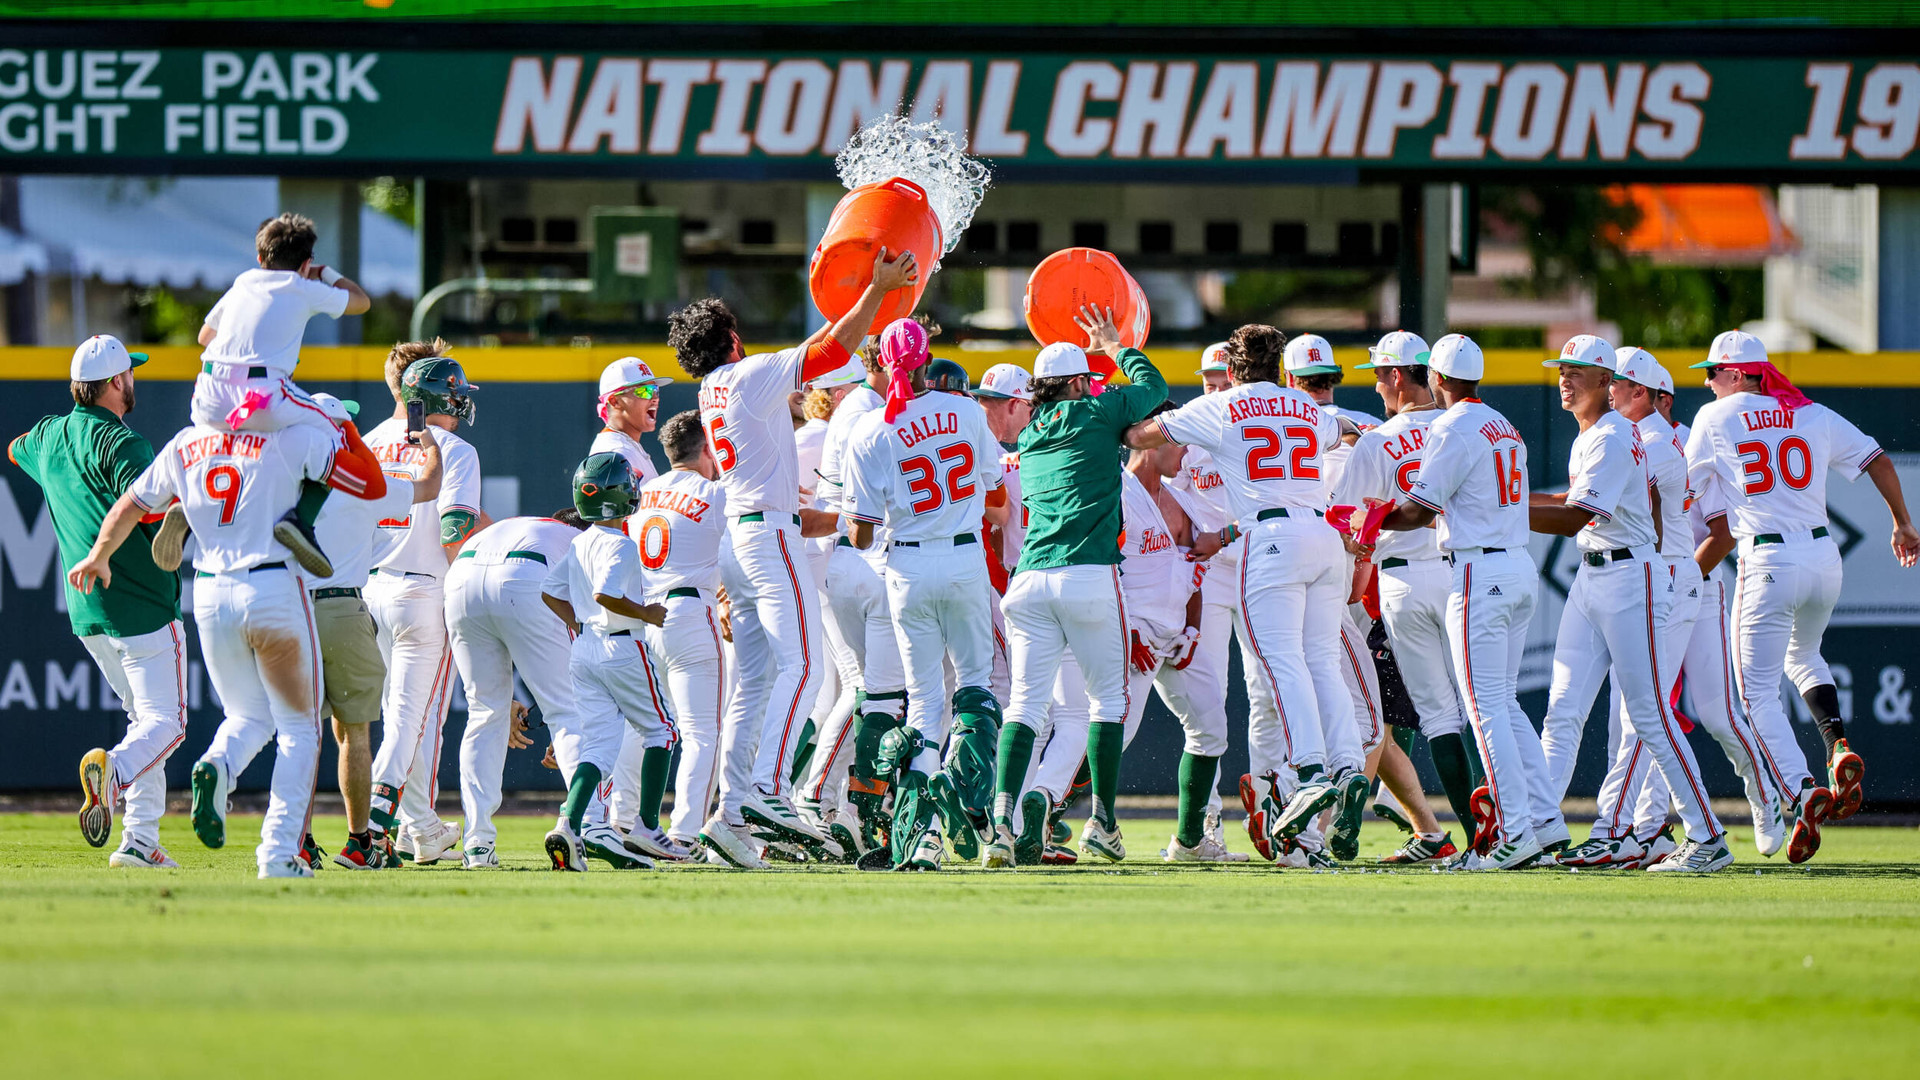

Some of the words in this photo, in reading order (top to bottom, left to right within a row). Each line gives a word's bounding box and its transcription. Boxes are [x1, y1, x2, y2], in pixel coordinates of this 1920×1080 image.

[0, 51, 161, 99] GUEZ
[203, 53, 380, 102] PARK
[0, 105, 129, 152] GHT
[165, 106, 349, 154] FIELD
[493, 56, 1030, 156] NATIONAL
[1045, 60, 1711, 159] CHAMPIONS
[1789, 61, 1920, 160] 19
[897, 412, 958, 448] GALLO
[1229, 396, 1317, 426] ARGUELLES
[1743, 409, 1794, 431] LIGON
[178, 433, 266, 470] LEVENSON
[702, 414, 739, 474] 5
[1241, 425, 1320, 482] 22
[1383, 427, 1428, 460] CAR
[1735, 435, 1813, 497] 30
[204, 463, 244, 527] 9
[898, 440, 976, 516] 32
[1493, 446, 1522, 507] 16
[640, 491, 710, 523] ONZALEZ
[639, 515, 671, 571] 0
